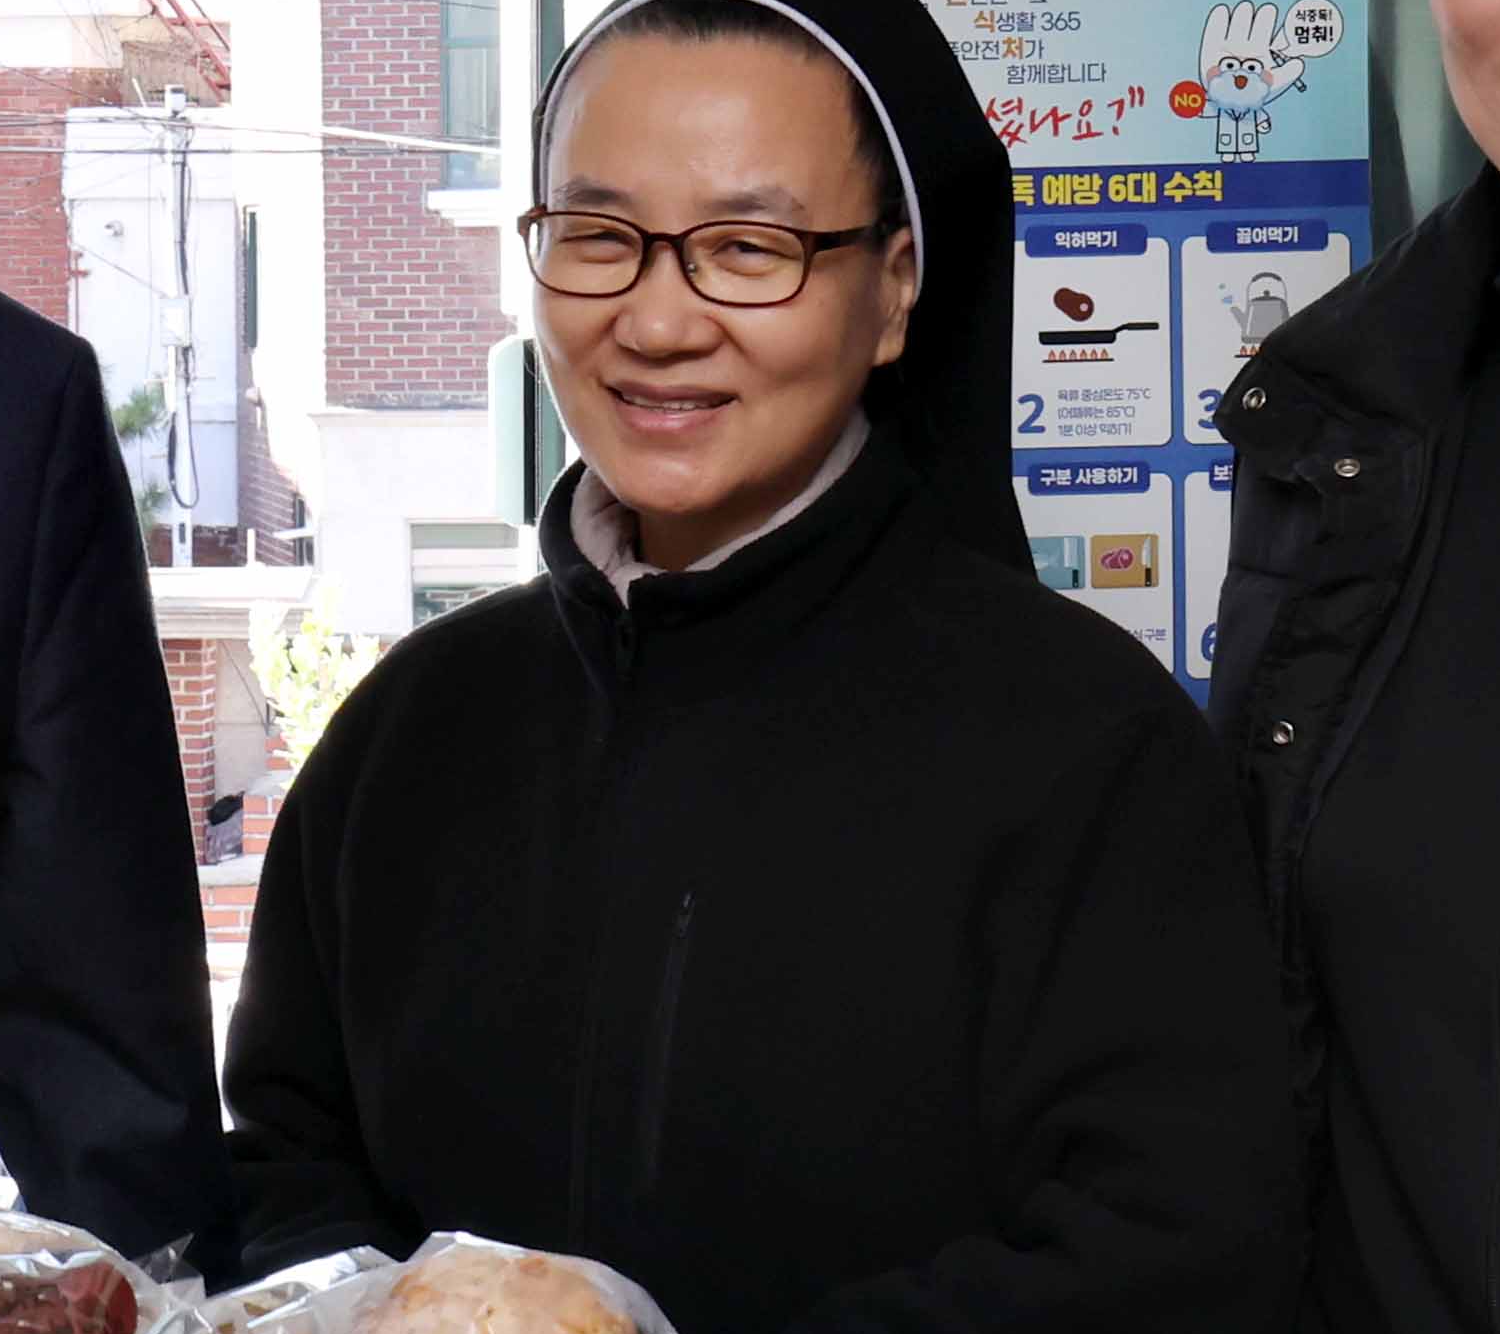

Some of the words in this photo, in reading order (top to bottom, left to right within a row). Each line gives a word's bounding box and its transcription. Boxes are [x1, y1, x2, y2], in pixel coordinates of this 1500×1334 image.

[974, 10, 1037, 33] 식생활
[1040, 11, 1081, 32] 365
[1295, 9, 1333, 23] 식중독!
[1295, 26, 1334, 44] 멈춰!
[1006, 63, 1107, 85] 함께합니다
[1174, 93, 1202, 108] NO
[1042, 172, 1102, 206] 예방
[1108, 171, 1156, 204] 6대
[1163, 170, 1224, 202] 수칙
[1236, 226, 1299, 245] 끓여먹기
[1017, 394, 1046, 434] 2
[1040, 469, 1072, 486] 구분
[1075, 467, 1139, 485] 사용하기
[1213, 466, 1233, 481] 보
